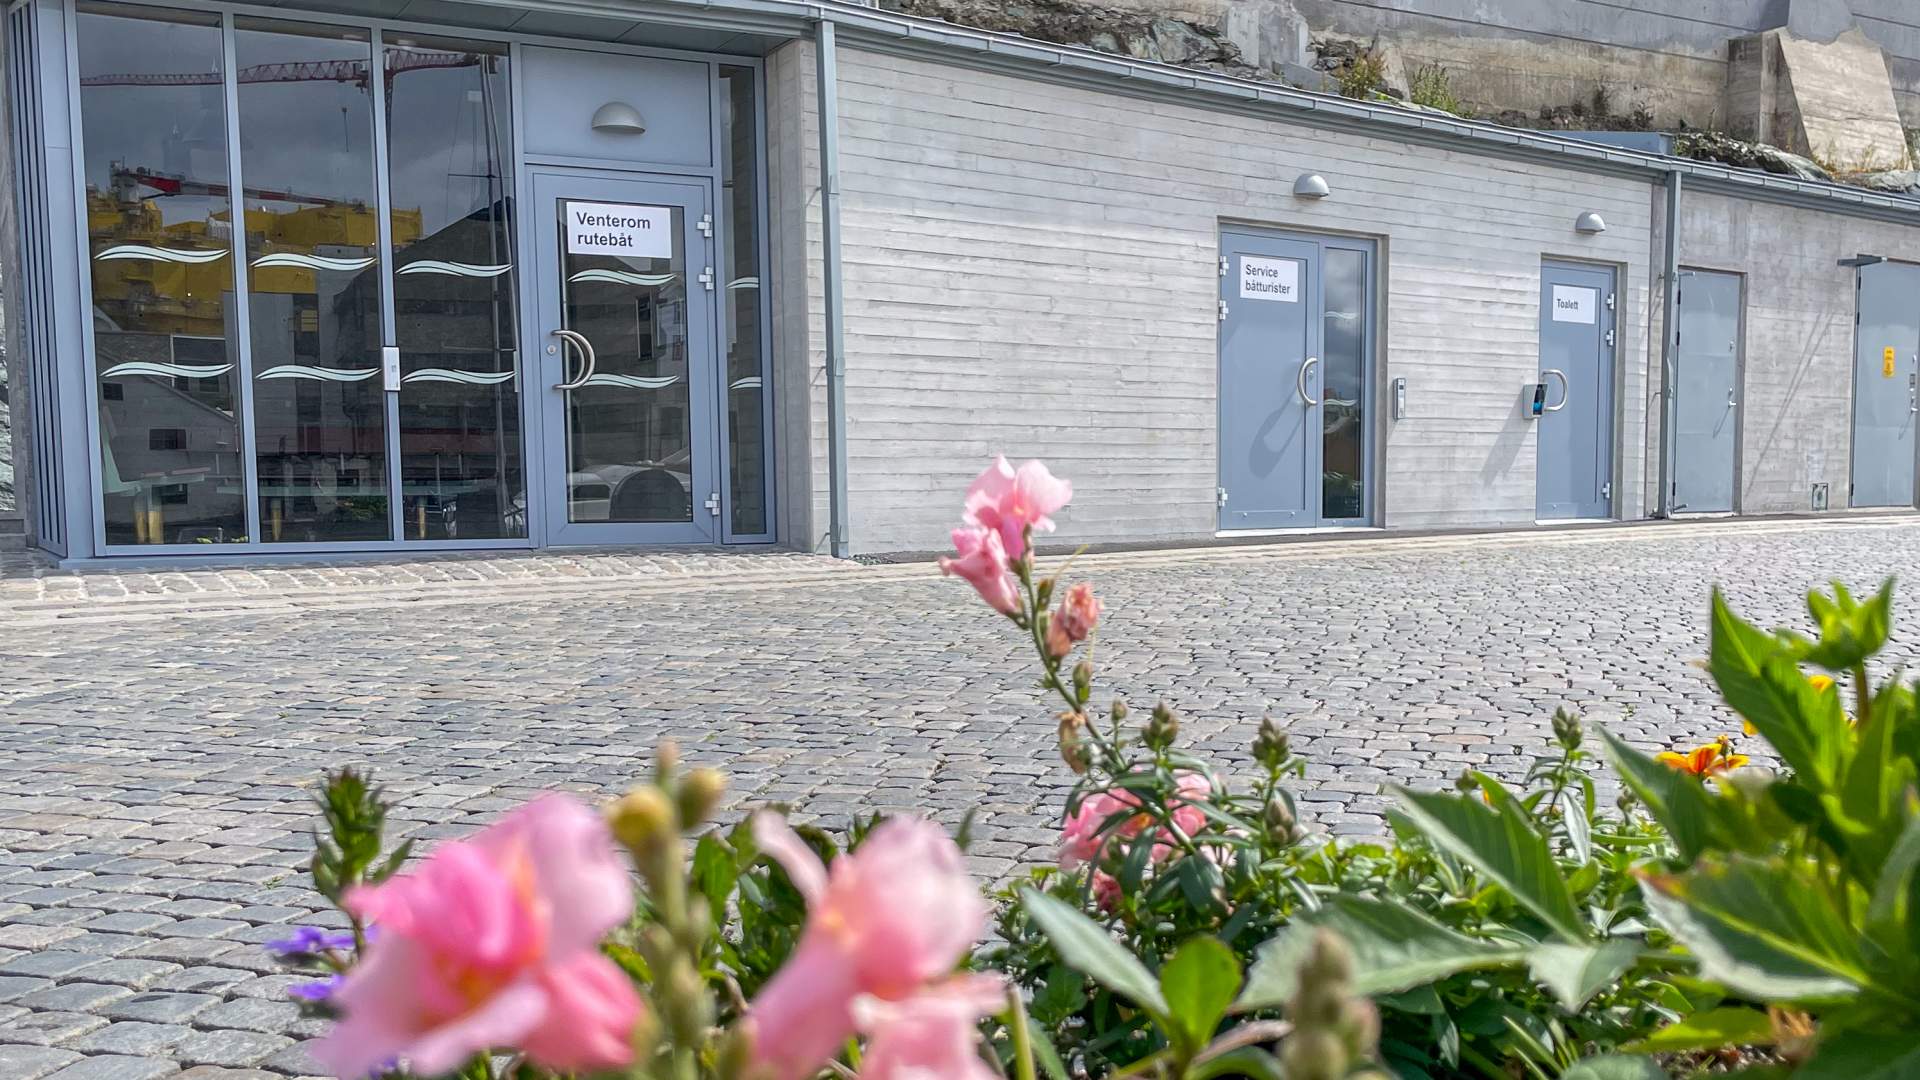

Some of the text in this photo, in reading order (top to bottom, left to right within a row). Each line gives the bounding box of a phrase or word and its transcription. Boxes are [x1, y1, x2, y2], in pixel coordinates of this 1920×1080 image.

[576, 211, 651, 229] Venterom
[577, 232, 633, 247] rutebåt
[1245, 264, 1279, 278] Service
[1245, 279, 1291, 294] båtturister
[1557, 298, 1579, 310] Toalett
